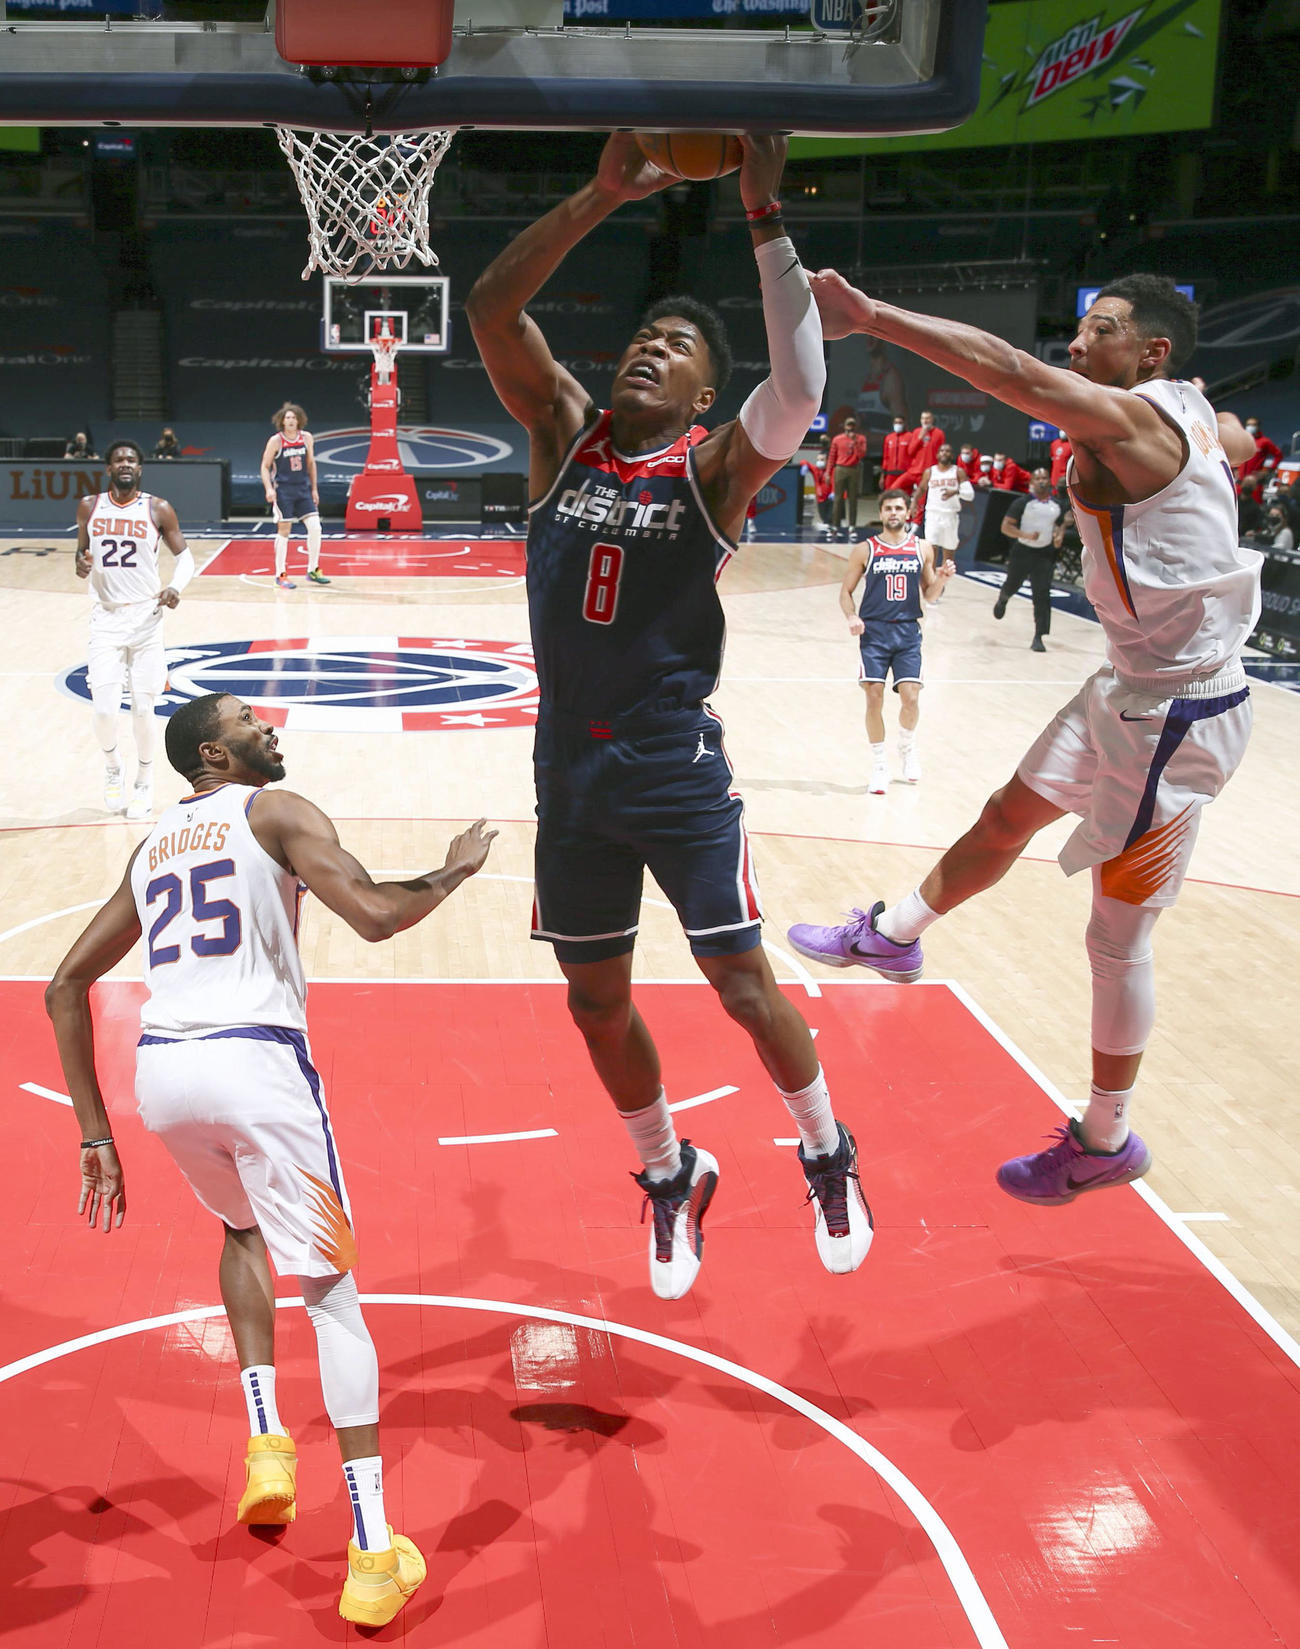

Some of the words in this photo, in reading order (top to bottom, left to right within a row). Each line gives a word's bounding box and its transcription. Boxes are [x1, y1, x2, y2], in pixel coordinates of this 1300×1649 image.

[821, 0, 855, 21] NBA
[10, 470, 106, 500] LiUN
[594, 485, 619, 499] THE
[557, 478, 686, 531] district
[101, 539, 137, 568] 22
[582, 542, 625, 625] 8
[885, 574, 908, 602] 19
[149, 822, 230, 872] BRIDGES
[146, 858, 242, 970] 25
